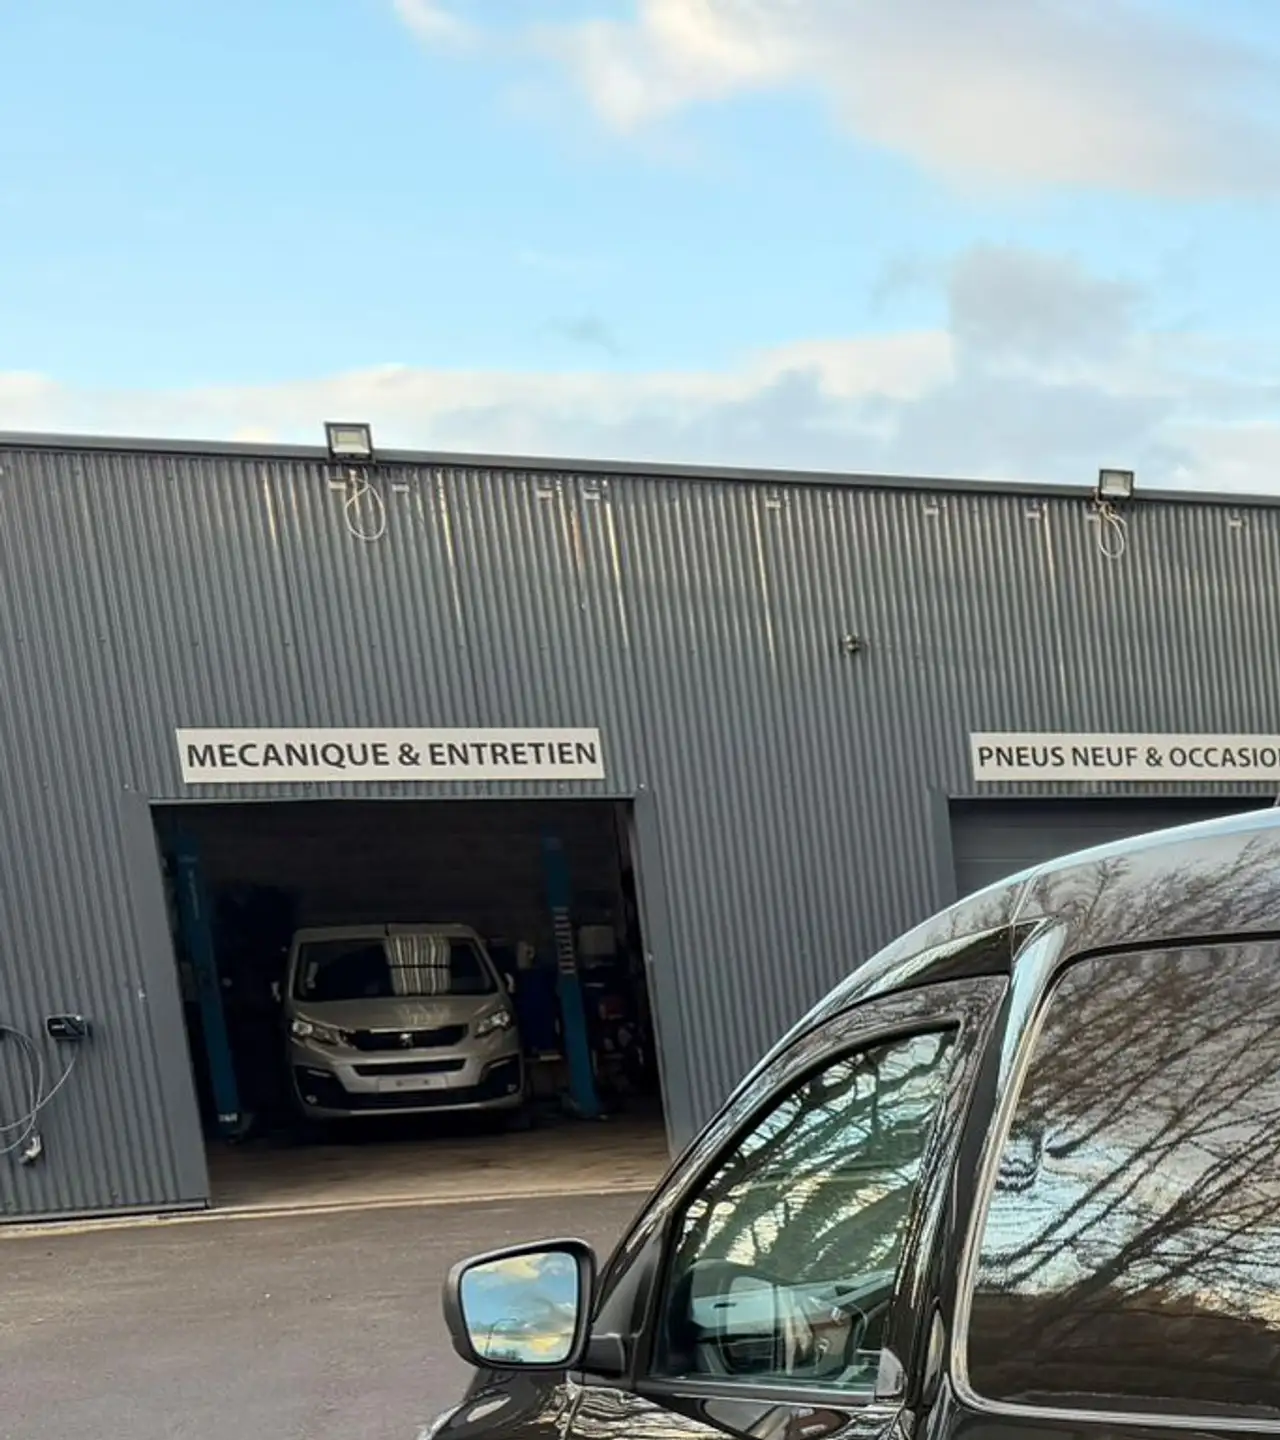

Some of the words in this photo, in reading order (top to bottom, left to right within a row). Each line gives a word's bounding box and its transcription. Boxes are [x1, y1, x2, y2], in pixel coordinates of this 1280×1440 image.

[187, 743, 389, 768] MECANIQUE
[398, 742, 421, 766] &
[429, 742, 597, 766] ENTRETIEN
[979, 746, 1065, 768] PNEUS
[1072, 747, 1139, 768] NEUF
[1145, 747, 1163, 768] &
